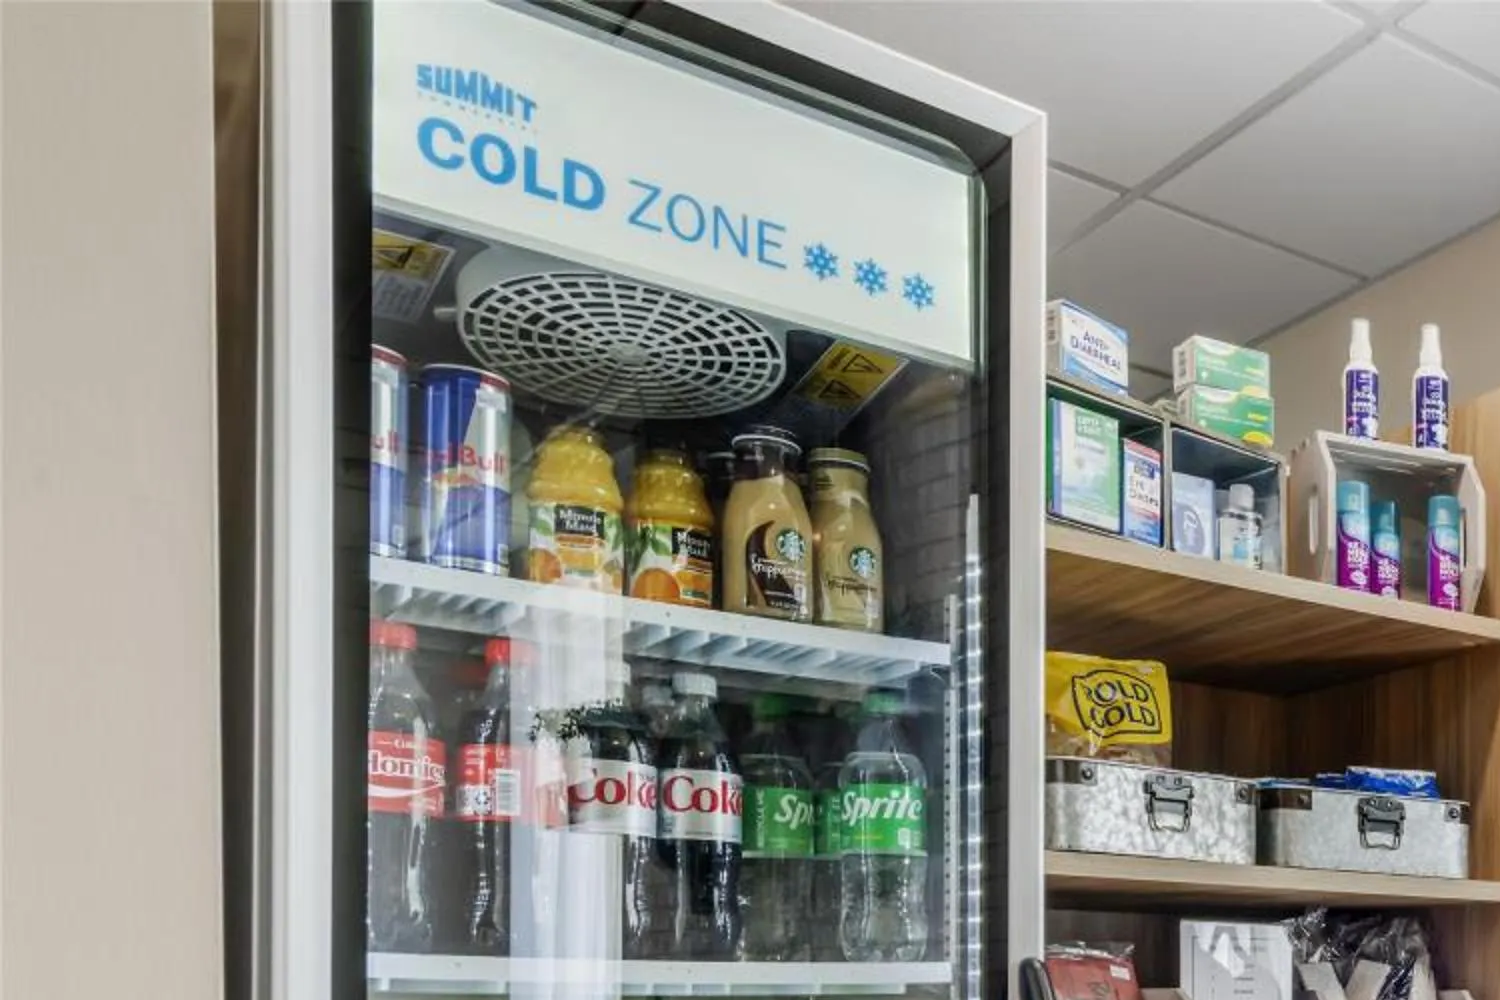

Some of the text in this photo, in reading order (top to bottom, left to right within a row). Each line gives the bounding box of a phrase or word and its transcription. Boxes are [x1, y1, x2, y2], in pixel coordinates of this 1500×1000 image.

[416, 63, 538, 123] SUMMIT
[416, 117, 788, 271] COLD ZONE
[371, 430, 399, 453] ull
[1089, 703, 1156, 728] GOLD
[841, 790, 922, 826] Sprite
